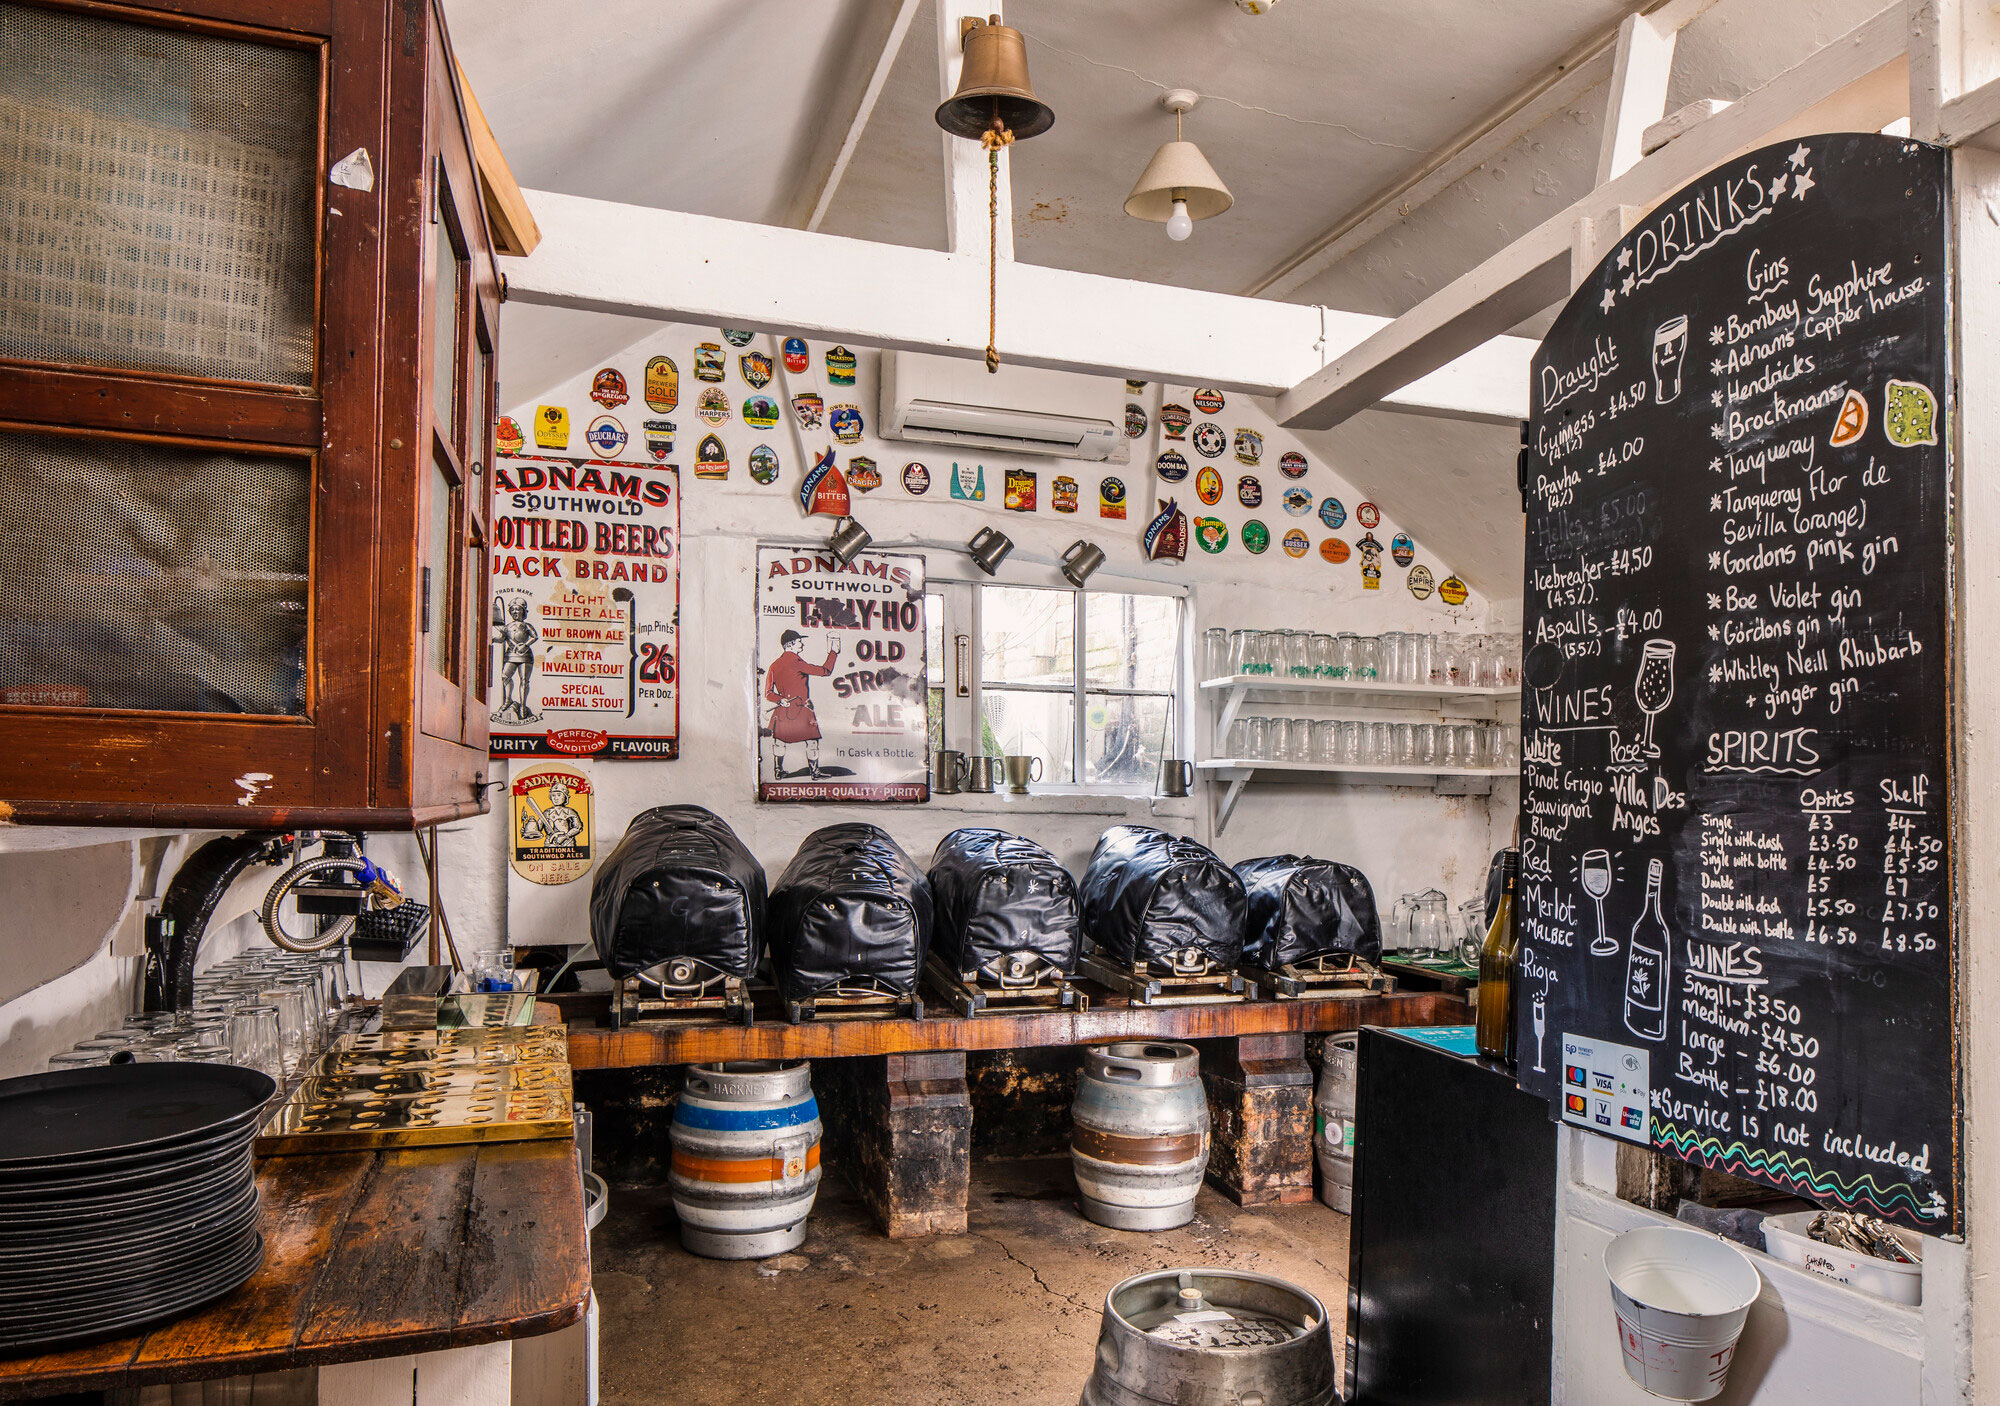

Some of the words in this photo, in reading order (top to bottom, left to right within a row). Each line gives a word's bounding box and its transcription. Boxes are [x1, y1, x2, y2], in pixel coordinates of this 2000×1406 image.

[1635, 164, 1765, 277] DRINKS
[1747, 249, 1789, 292] Gins
[1727, 299, 1800, 344] Bombay
[1807, 260, 1892, 315] Sapphire
[1805, 305, 1862, 342] Copper
[747, 372, 768, 380] FOX
[1542, 335, 1617, 407] Draught
[1728, 354, 1816, 403] Hendricks
[648, 386, 676, 398] GOLD
[1609, 381, 1646, 419] £4.50
[644, 422, 676, 430] LANCASTER
[1729, 385, 1840, 442] Brockmans
[537, 431, 569, 440] ODYSSEY
[589, 432, 625, 442] DEUCHARS
[1538, 465, 1581, 500] Pravha
[1598, 437, 1644, 476] £4.00
[1725, 436, 1814, 484] Tanqueray
[495, 467, 671, 507] ADNAMS
[801, 464, 828, 502] ADNAMS
[1723, 486, 1801, 519] Tanqueray
[1809, 466, 1848, 500] Flor
[1863, 456, 1890, 486] de
[512, 493, 643, 516] SOUTHWOLD
[1145, 513, 1171, 548] ADNAMS
[1177, 516, 1185, 556] BROADSIDE
[1200, 520, 1226, 530] Humpty
[1723, 512, 1786, 545] Sevilla
[1793, 498, 1867, 537] (orange)
[494, 516, 588, 552] OTTLED
[593, 521, 674, 559] BEERS
[1285, 540, 1307, 548] SUSSEX
[493, 555, 561, 578] JACK
[575, 560, 667, 583] BRAND
[768, 556, 911, 584] ADNAMS
[1723, 543, 1796, 575] Gordons
[1807, 539, 1854, 570] pink
[1862, 536, 1898, 575] gin
[792, 580, 892, 594] SOUTHWOLD
[1409, 578, 1434, 589] EMPIRE
[1535, 555, 1604, 591] Icebreaker
[542, 606, 591, 618] BITTER
[599, 609, 624, 619] ALE
[563, 594, 605, 605] LIGHT
[763, 606, 795, 614] FAMOUS
[1726, 586, 1757, 611] Boe
[1770, 582, 1821, 608] Violet
[1831, 586, 1861, 620] gin
[542, 628, 561, 638] NUT
[566, 628, 601, 639] BROWN
[605, 632, 624, 641] ALE
[566, 650, 602, 661] EXTRA
[640, 642, 675, 684] 2/6
[856, 640, 905, 663] OLD
[1723, 654, 1779, 691] Whitley
[1787, 648, 1828, 675] Neill
[1839, 631, 1922, 671] Rhubarb
[542, 662, 585, 673] INVALID
[590, 663, 624, 674] STOUT
[542, 697, 587, 707] OATMEAL
[593, 698, 624, 708] STOUT
[562, 685, 604, 695] SPECIAL
[1535, 685, 1612, 724] WINES
[1765, 685, 1818, 719] ginger
[852, 705, 904, 727] ALE
[550, 739, 604, 752] CONDITION
[557, 731, 598, 739] PERFECT
[613, 742, 670, 752] FLAVOUR
[1524, 730, 1561, 760] White
[1610, 730, 1644, 763] Rosé
[1707, 727, 1819, 765] SPIRITS
[836, 748, 845, 756] In
[848, 748, 873, 757] Cask
[523, 775, 580, 789] ADNAMS
[768, 788, 827, 796] STRENGTH
[832, 788, 878, 796] QUALITY
[883, 788, 920, 796] PURITY
[1528, 765, 1558, 790] Pinot
[1564, 767, 1602, 803] Grigio
[1613, 773, 1648, 808] Villa
[1654, 776, 1685, 809] Des
[1800, 788, 1855, 810] Optics
[1880, 773, 1928, 807] Shelf
[1526, 791, 1592, 830] Sauvignon
[1612, 804, 1660, 842] Anges
[1531, 815, 1562, 842] Blanc
[1702, 813, 1733, 834] Single
[1808, 814, 1834, 832] £3
[1888, 814, 1916, 837] £4
[1523, 838, 1552, 874] Red
[1701, 832, 1732, 853] Single
[1735, 831, 1756, 847] with
[1757, 834, 1783, 851] dash
[1809, 834, 1859, 852] £3.50
[1885, 835, 1943, 857] £4.50
[540, 874, 570, 882] HERE
[551, 862, 580, 871] SALE
[1733, 852, 1754, 868] with
[1757, 853, 1787, 871] bottle
[1884, 855, 1938, 874] £5.50
[1701, 872, 1734, 890] Double
[1808, 874, 1831, 893] £5
[1886, 876, 1908, 897] £7
[1526, 884, 1576, 926] Merlot
[1701, 893, 1734, 911] Double
[1756, 896, 1781, 914] dash
[1807, 898, 1855, 916] £5.50
[1882, 901, 1938, 923] £7.50
[1527, 918, 1574, 947] MALBEC
[1764, 919, 1794, 940] bottle
[1805, 920, 1857, 944] £6.50
[1882, 927, 1936, 952] £8.50
[1524, 948, 1558, 996] Rioja
[1687, 939, 1763, 976] WINES
[1683, 974, 1731, 1008] Small
[1682, 1020, 1725, 1065] large
[1755, 1051, 1815, 1085] £6.00
[714, 1084, 767, 1095] HACKNEY
[1595, 1078, 1612, 1090] VISA
[1675, 1052, 1729, 1098] Bottle
[1756, 1078, 1818, 1112] £18.00
[1599, 1103, 1606, 1114] V
[1661, 1087, 1731, 1132] Service
[1742, 1105, 1759, 1138] is
[1774, 1122, 1810, 1147] not
[1823, 1129, 1931, 1174] included
